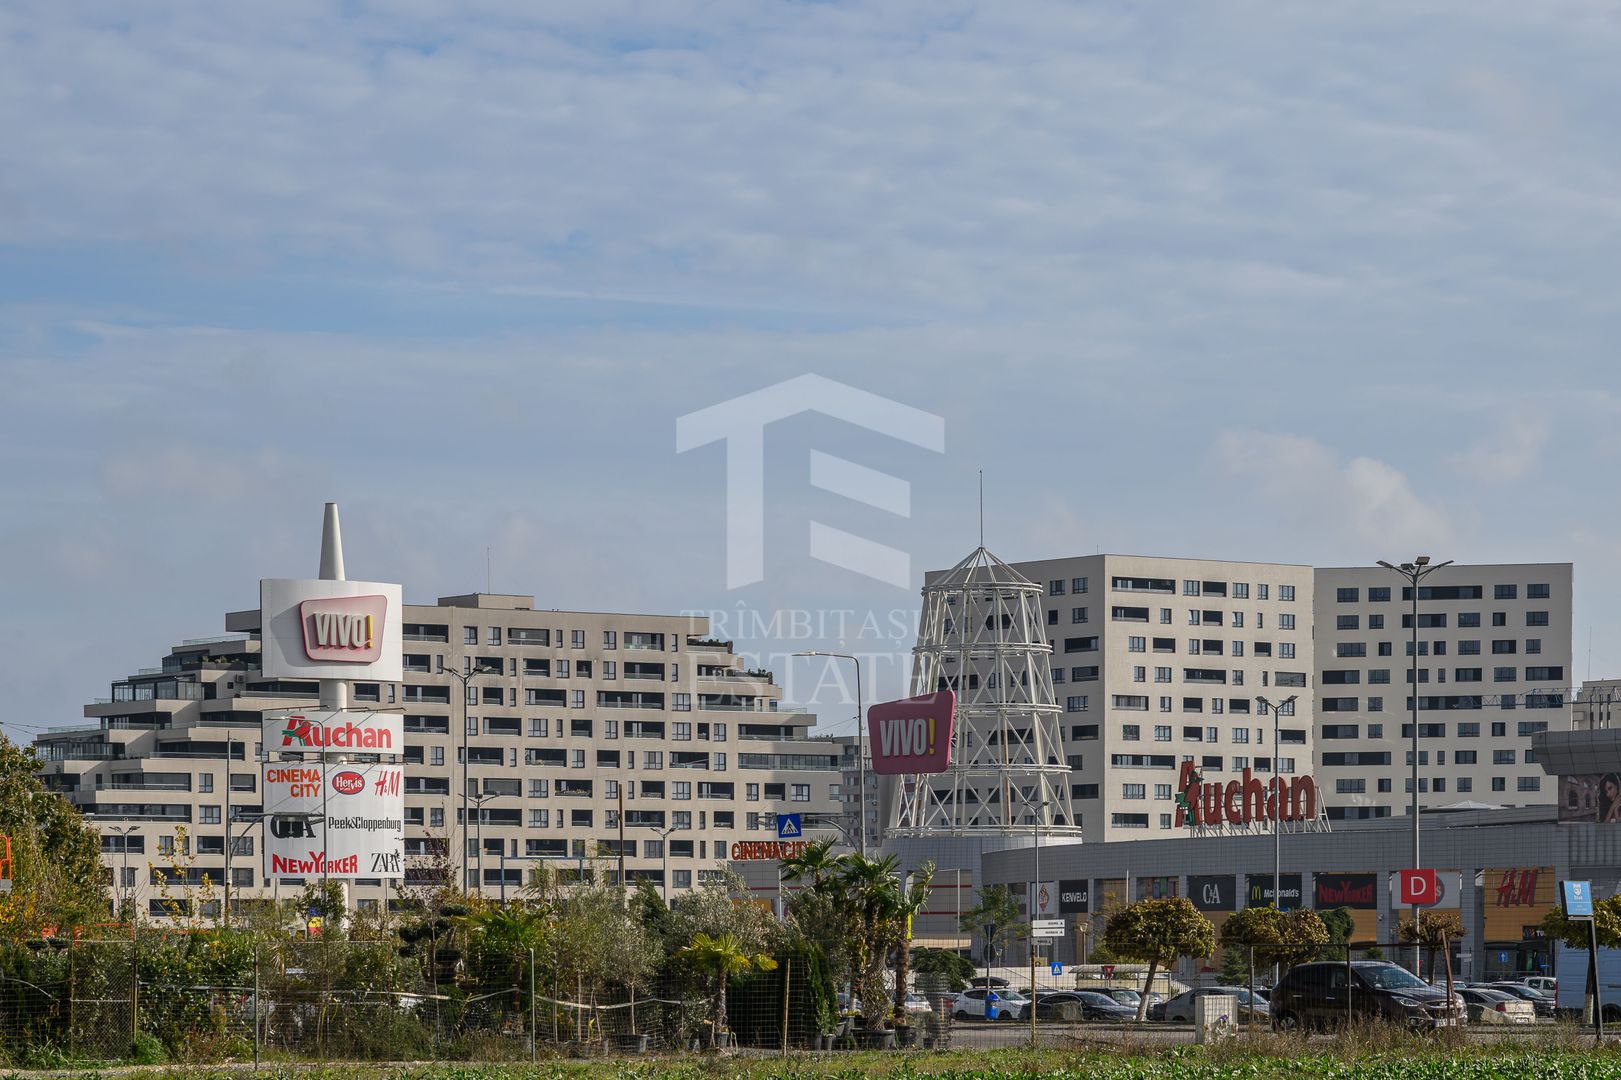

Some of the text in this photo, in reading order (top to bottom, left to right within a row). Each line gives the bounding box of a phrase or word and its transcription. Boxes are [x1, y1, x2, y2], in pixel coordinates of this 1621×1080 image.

[314, 613, 375, 648] VIVO!
[281, 715, 392, 748] Auchan
[879, 717, 936, 757] VIVO!
[266, 769, 321, 783] CINEMA
[335, 776, 363, 790] Hervis
[375, 770, 401, 797] H&M
[290, 783, 320, 797] CITY
[1174, 760, 1317, 827] Auchan
[370, 852, 401, 872] ZARA
[1202, 883, 1221, 904] C&A
[1410, 876, 1426, 896] D
